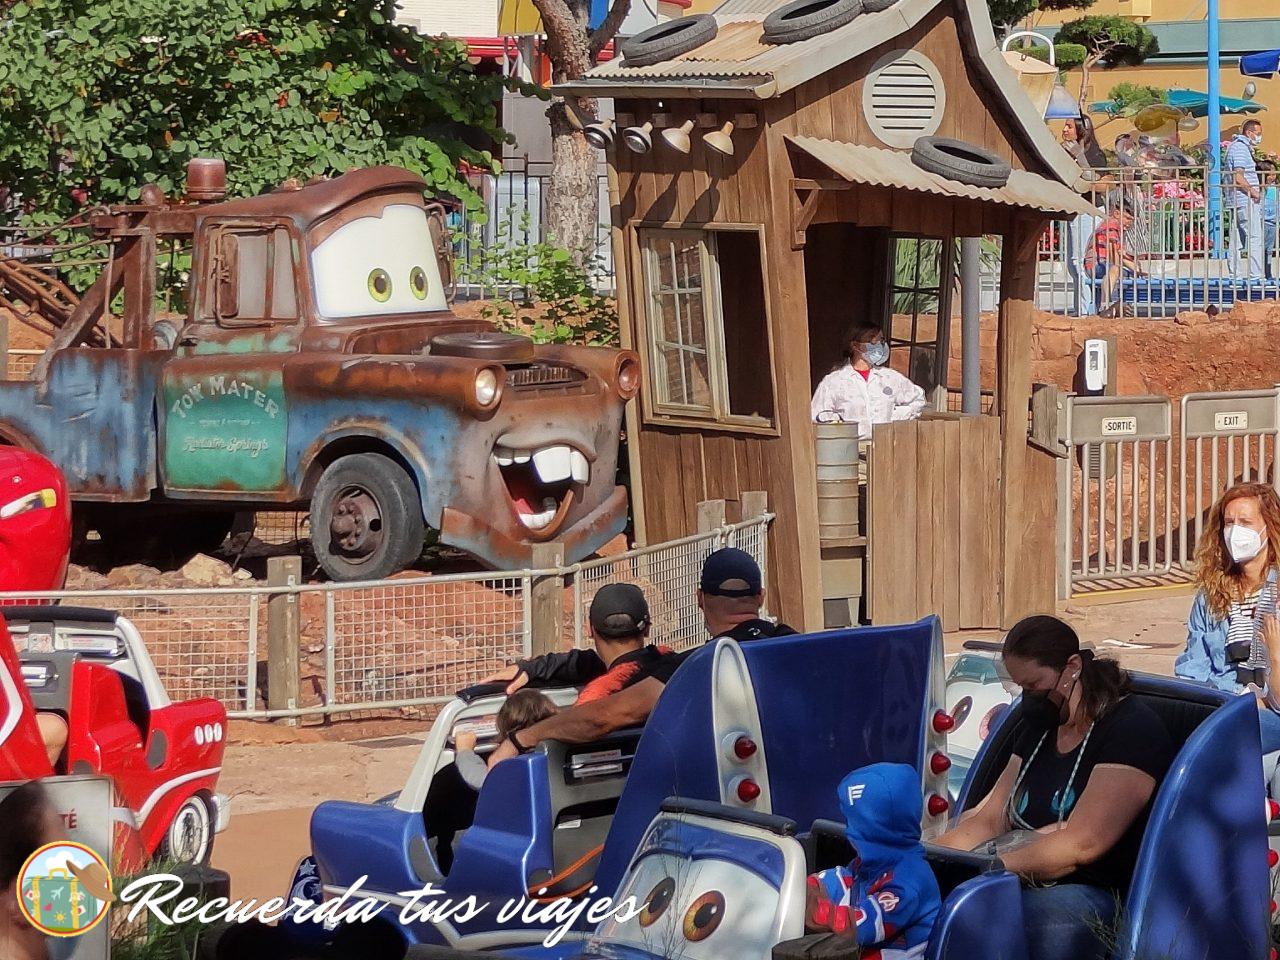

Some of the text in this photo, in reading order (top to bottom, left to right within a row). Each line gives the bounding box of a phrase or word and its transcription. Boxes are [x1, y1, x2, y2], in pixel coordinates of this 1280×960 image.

[209, 375, 280, 419] MATER
[1107, 421, 1133, 431] SORTIE
[1224, 416, 1239, 426] EXIT
